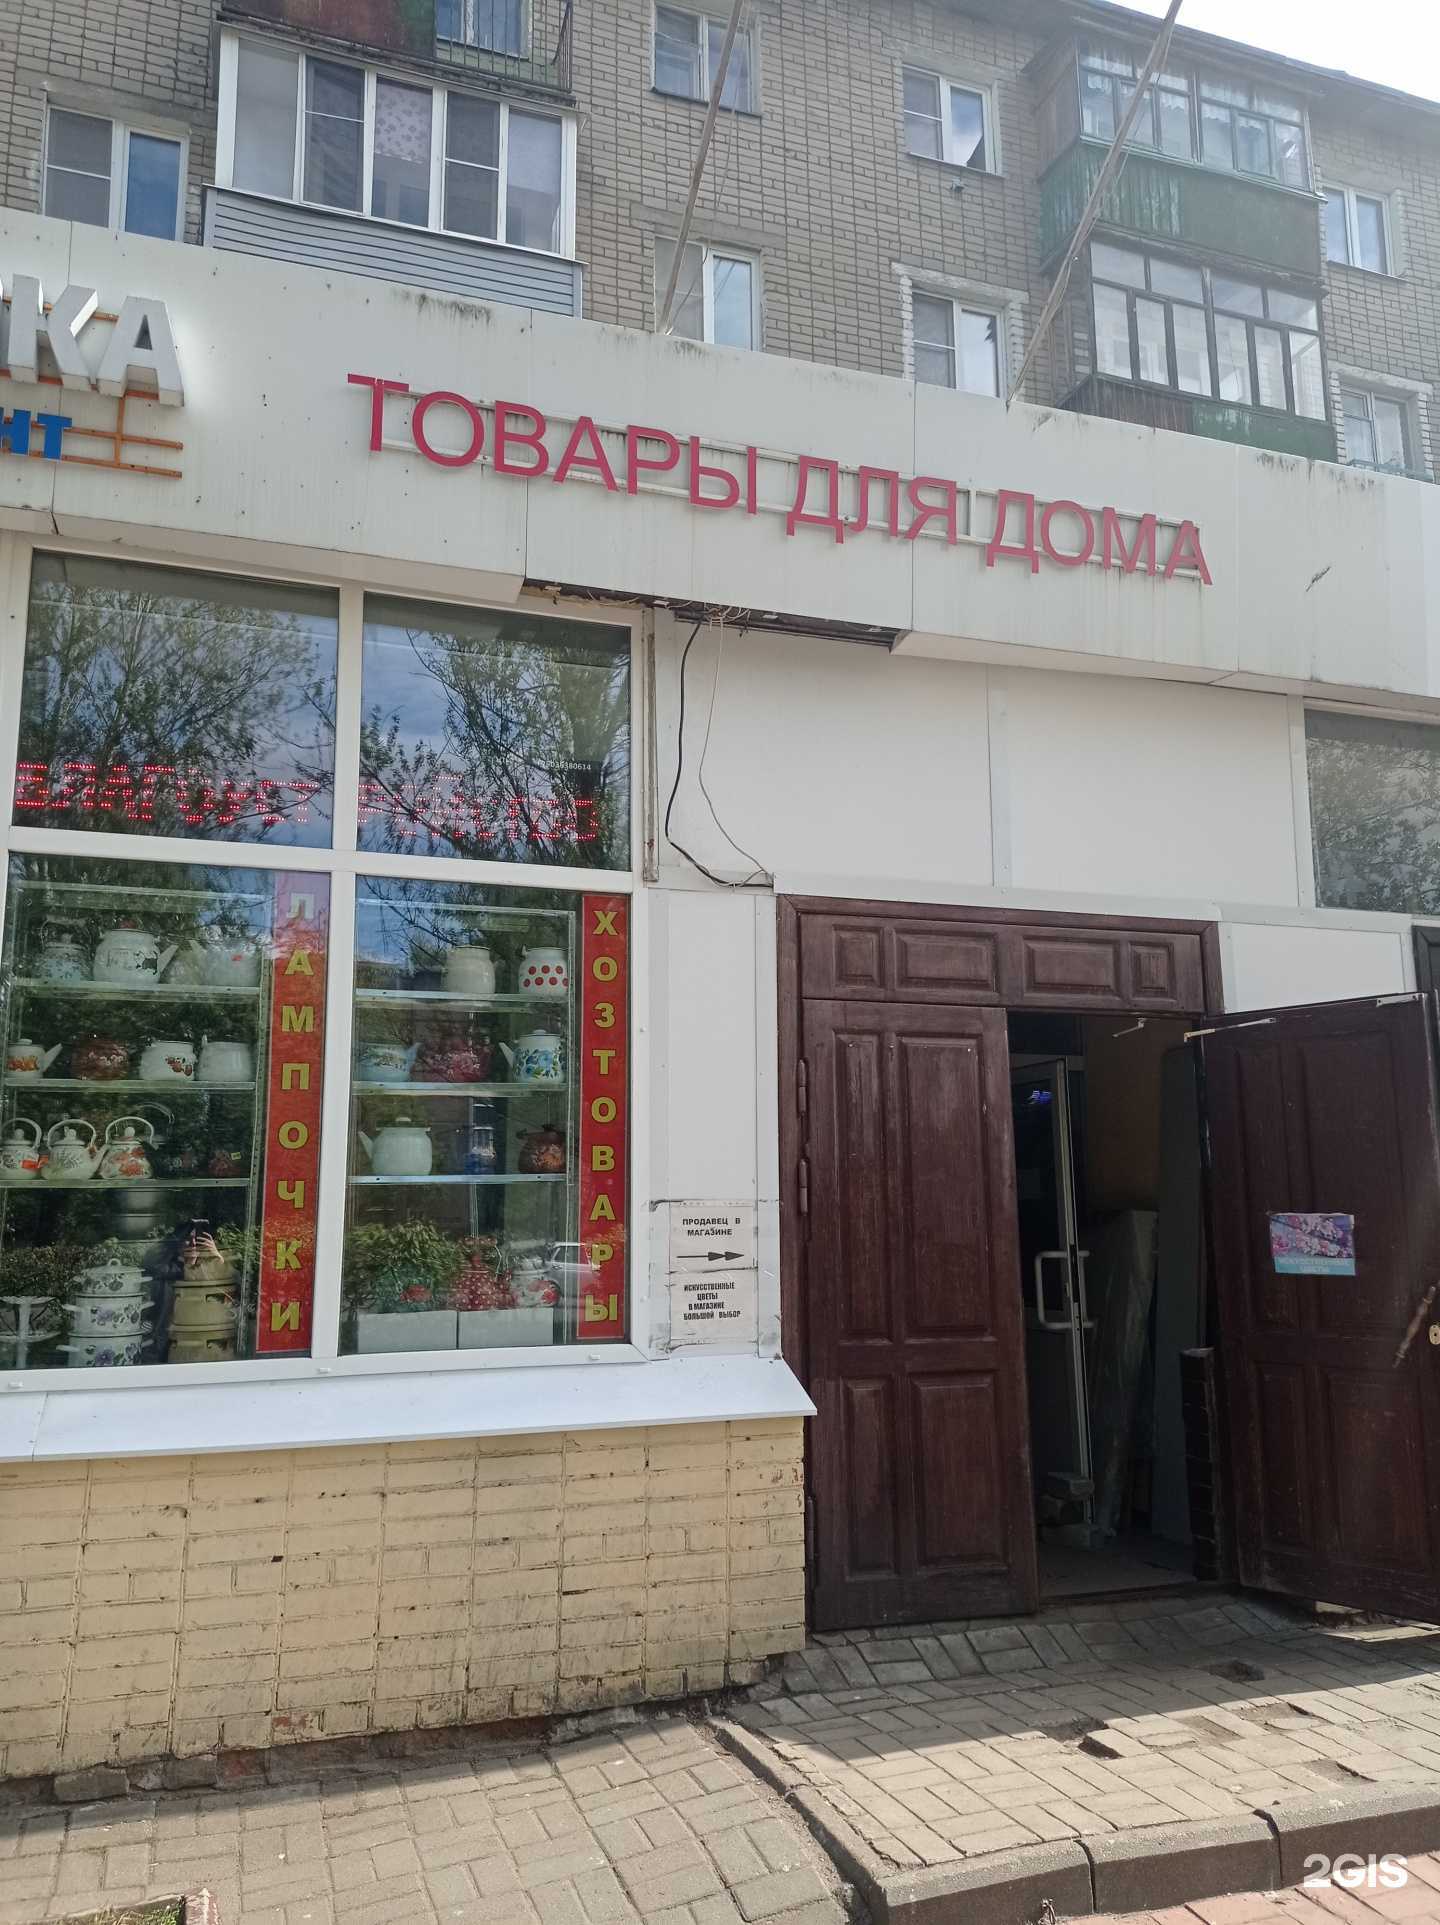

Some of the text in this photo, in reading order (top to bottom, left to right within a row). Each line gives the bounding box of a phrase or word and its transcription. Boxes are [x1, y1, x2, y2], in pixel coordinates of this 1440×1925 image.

[0, 270, 184, 408] КА
[347, 373, 1213, 585] ТОВАРЫ ДЛЯ ДОМА
[270, 893, 315, 1332] ЛАМПОЧКИ
[584, 911, 618, 1323] ХОЗТОВАРЫ
[682, 1217, 729, 1226] ПРОДАВЕЦ
[687, 1228, 733, 1237] МАГАЗИНЕ
[684, 1282, 735, 1292] ИСКУССТВЕННЫЕ
[697, 1293, 718, 1301] ЦВЕТЫ
[688, 1302, 725, 1311] В МАГАЗИНЕ
[683, 1310, 741, 1321] БОЛЬШОЙ ВЫБОР
